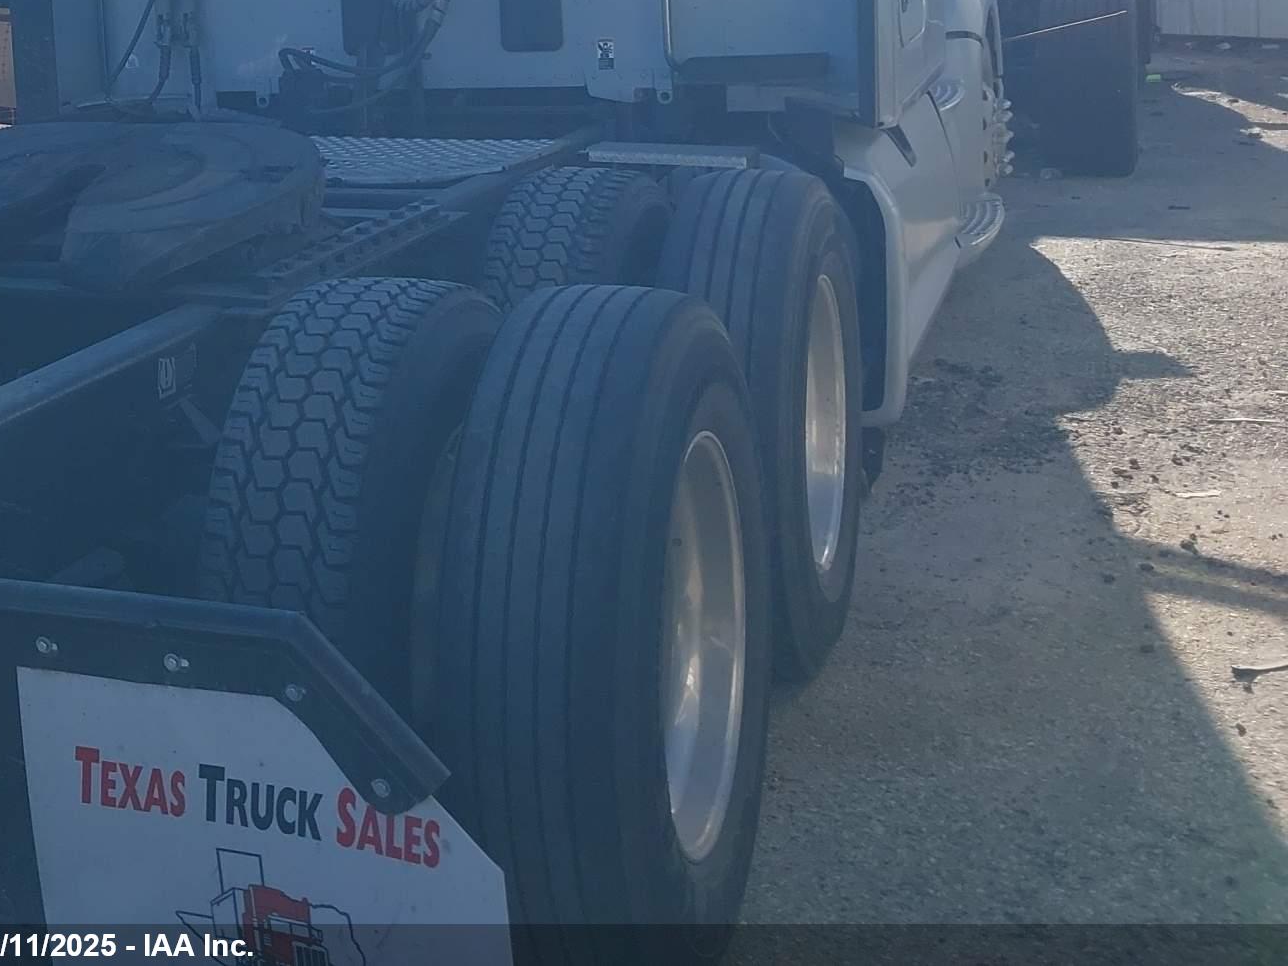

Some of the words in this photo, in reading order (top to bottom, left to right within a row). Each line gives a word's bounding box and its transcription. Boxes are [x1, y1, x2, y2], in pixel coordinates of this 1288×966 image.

[75, 746, 186, 817] TEXAS
[199, 764, 323, 841] TRUCK
[336, 786, 441, 868] SALES
